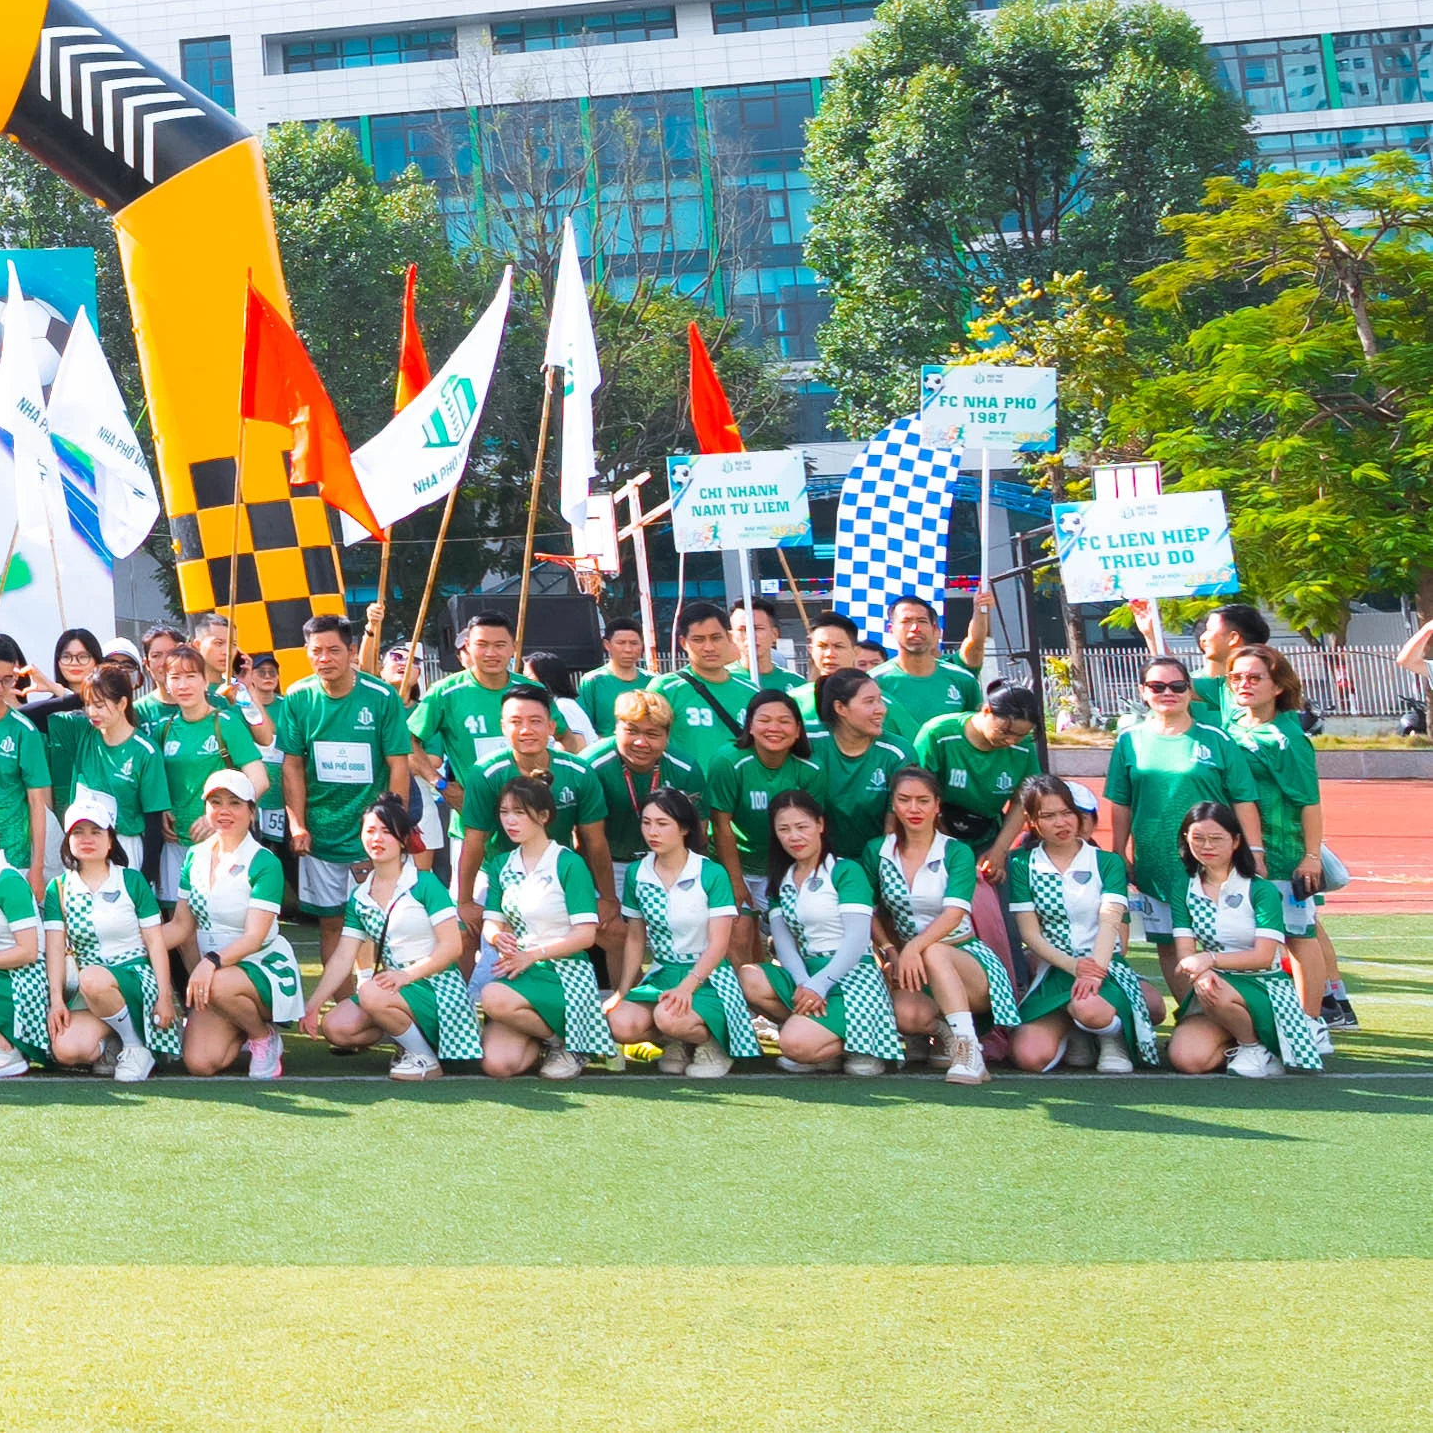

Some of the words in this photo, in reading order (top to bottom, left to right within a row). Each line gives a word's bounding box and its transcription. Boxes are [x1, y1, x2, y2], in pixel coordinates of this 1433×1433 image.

[938, 395, 958, 408] FC
[968, 411, 1007, 424] 1987
[699, 487, 722, 500] CHI
[691, 504, 726, 517] NAM
[1077, 536, 1101, 551] FC
[464, 714, 488, 734] 41
[685, 706, 713, 727] 33
[749, 790, 768, 810] 100
[261, 950, 297, 997] S
